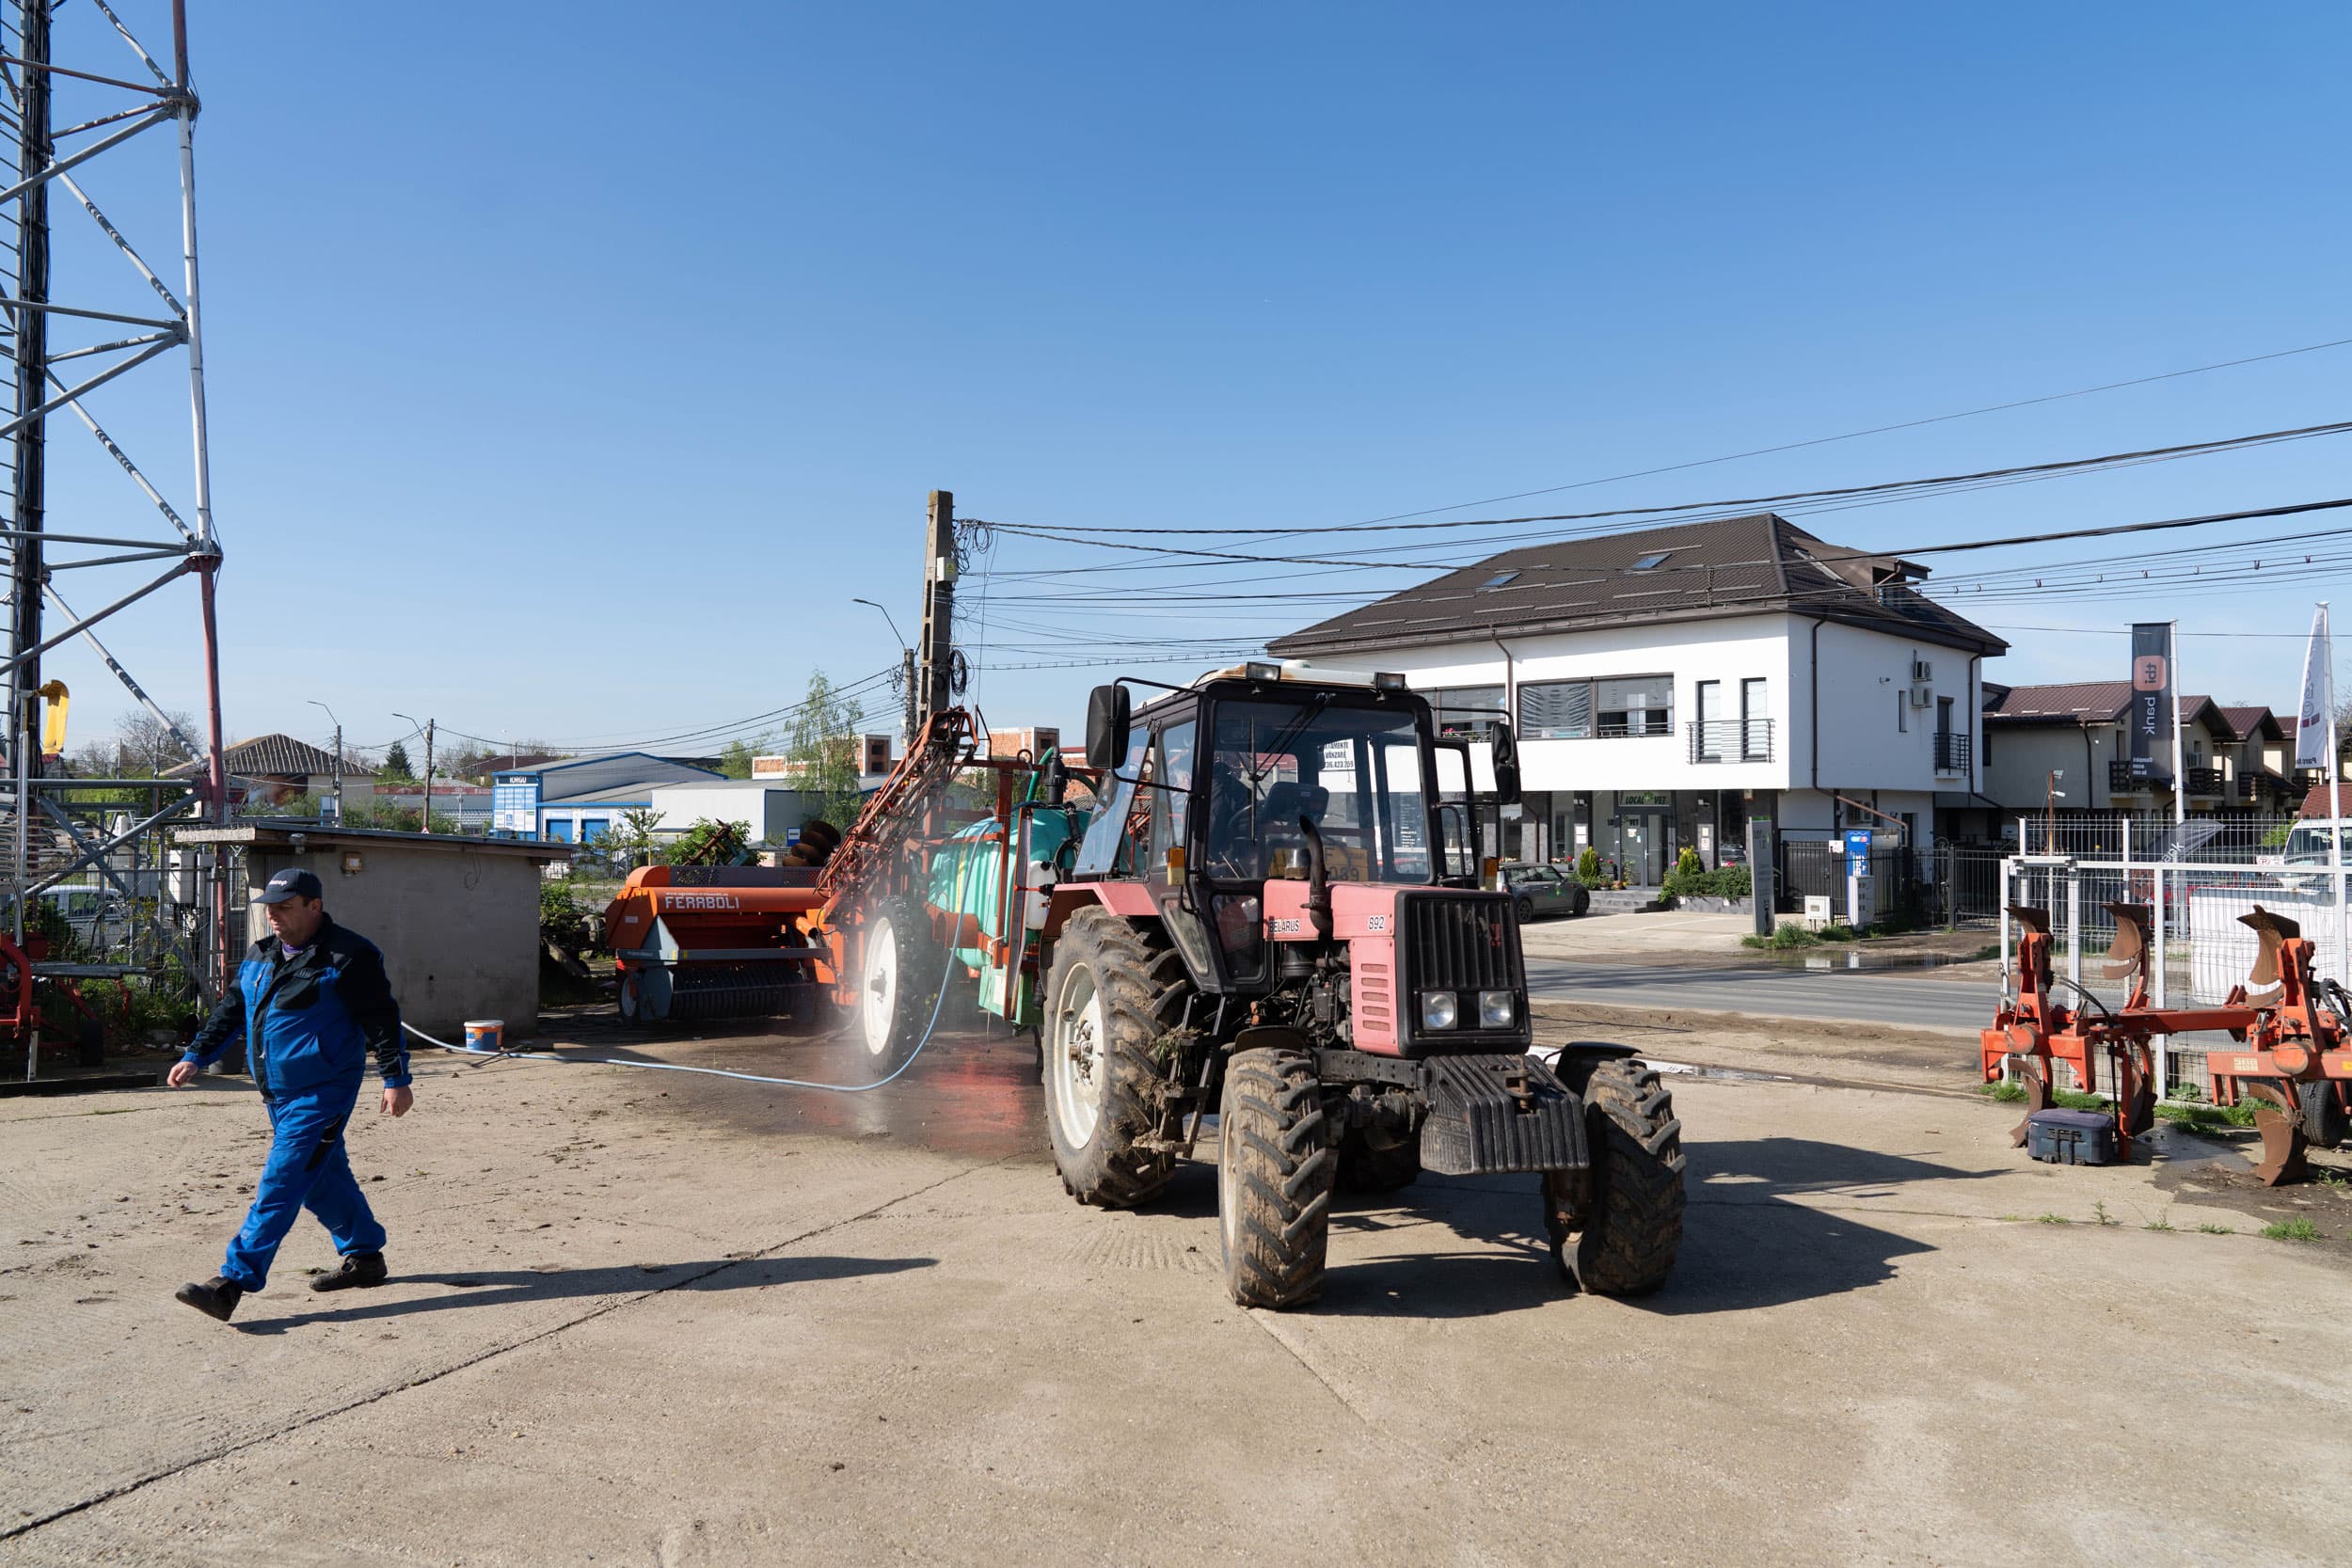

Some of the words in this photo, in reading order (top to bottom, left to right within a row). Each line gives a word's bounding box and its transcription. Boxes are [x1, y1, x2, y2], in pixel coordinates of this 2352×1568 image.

[1625, 796, 1645, 805] LOCAL
[1654, 796, 1666, 804] VET
[664, 896, 739, 910] FERABOLI
[1269, 920, 1299, 933] BELARUS
[1368, 917, 1385, 929] 892
